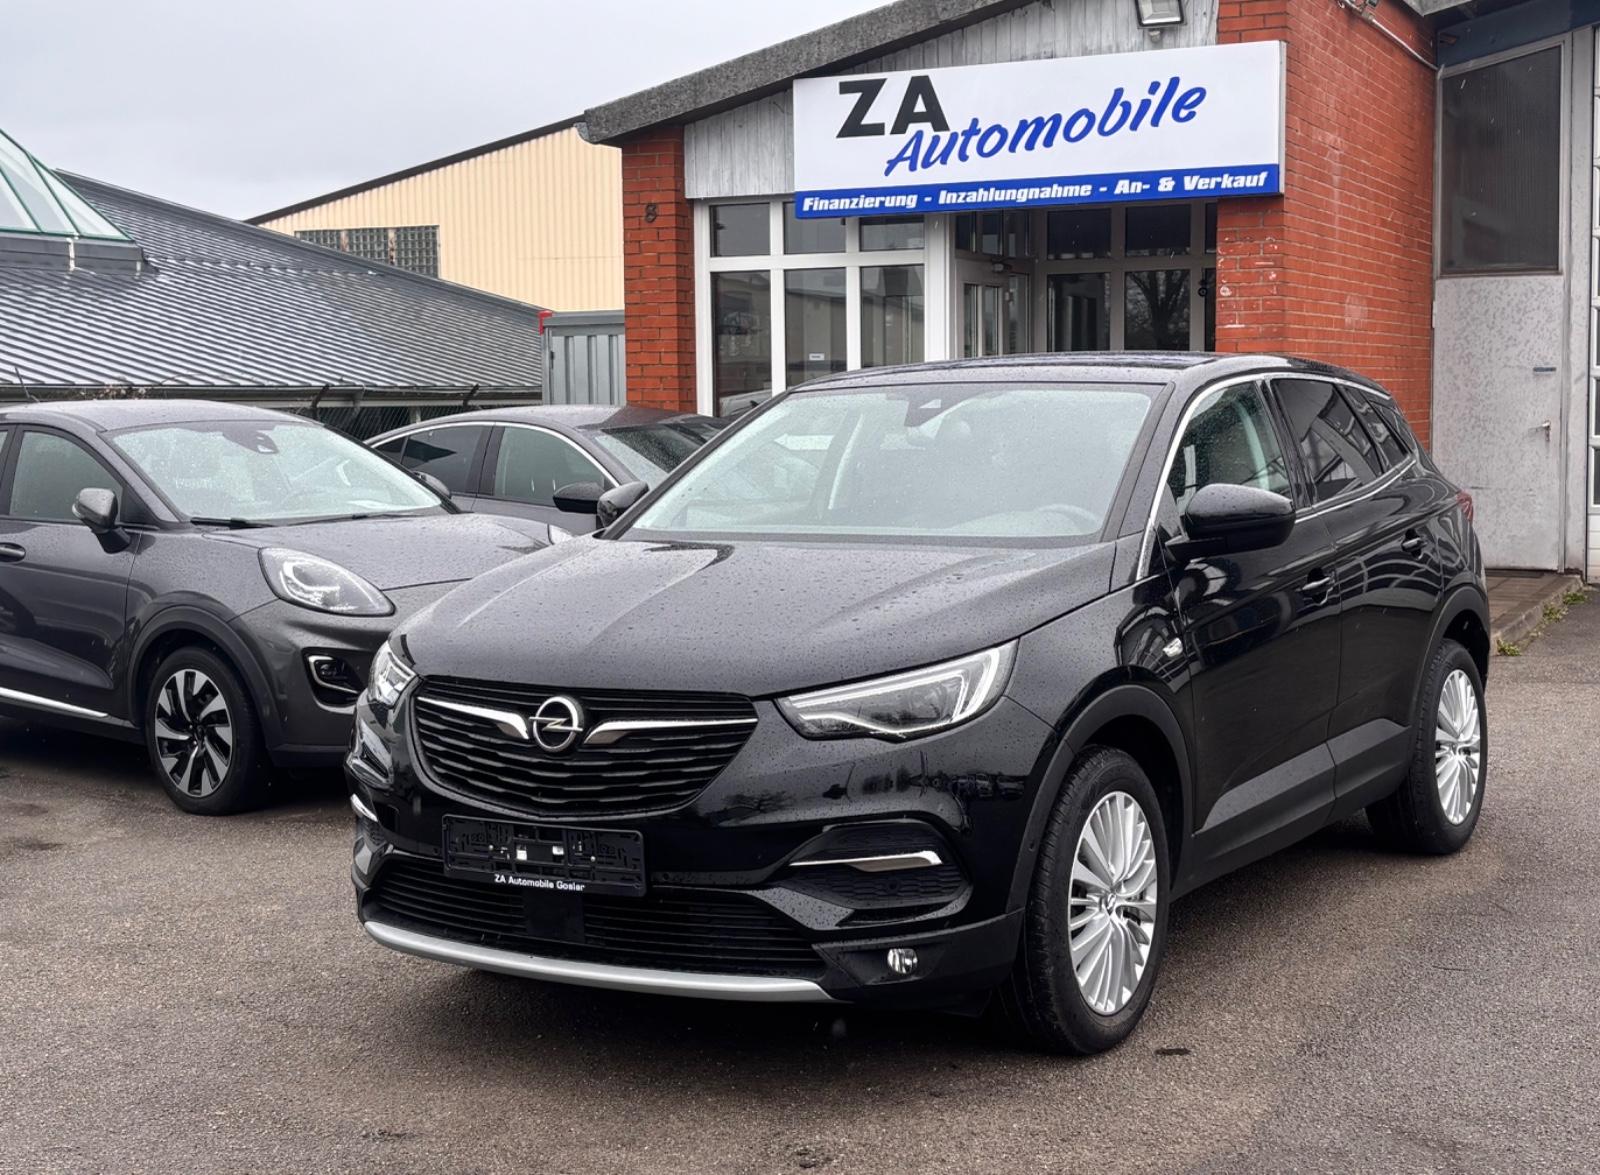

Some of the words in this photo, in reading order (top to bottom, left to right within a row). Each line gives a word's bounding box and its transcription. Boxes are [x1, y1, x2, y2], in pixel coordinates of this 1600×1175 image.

[836, 75, 950, 138] ZA
[884, 76, 1207, 177] Automobile
[802, 193, 917, 212] Finanzierung
[939, 182, 1092, 205] Inzahlungnahme
[1114, 179, 1150, 195] An-
[1157, 176, 1176, 192] &
[1183, 171, 1268, 191] Verkauf
[494, 873, 506, 884] ZA
[508, 876, 555, 889] Automobile
